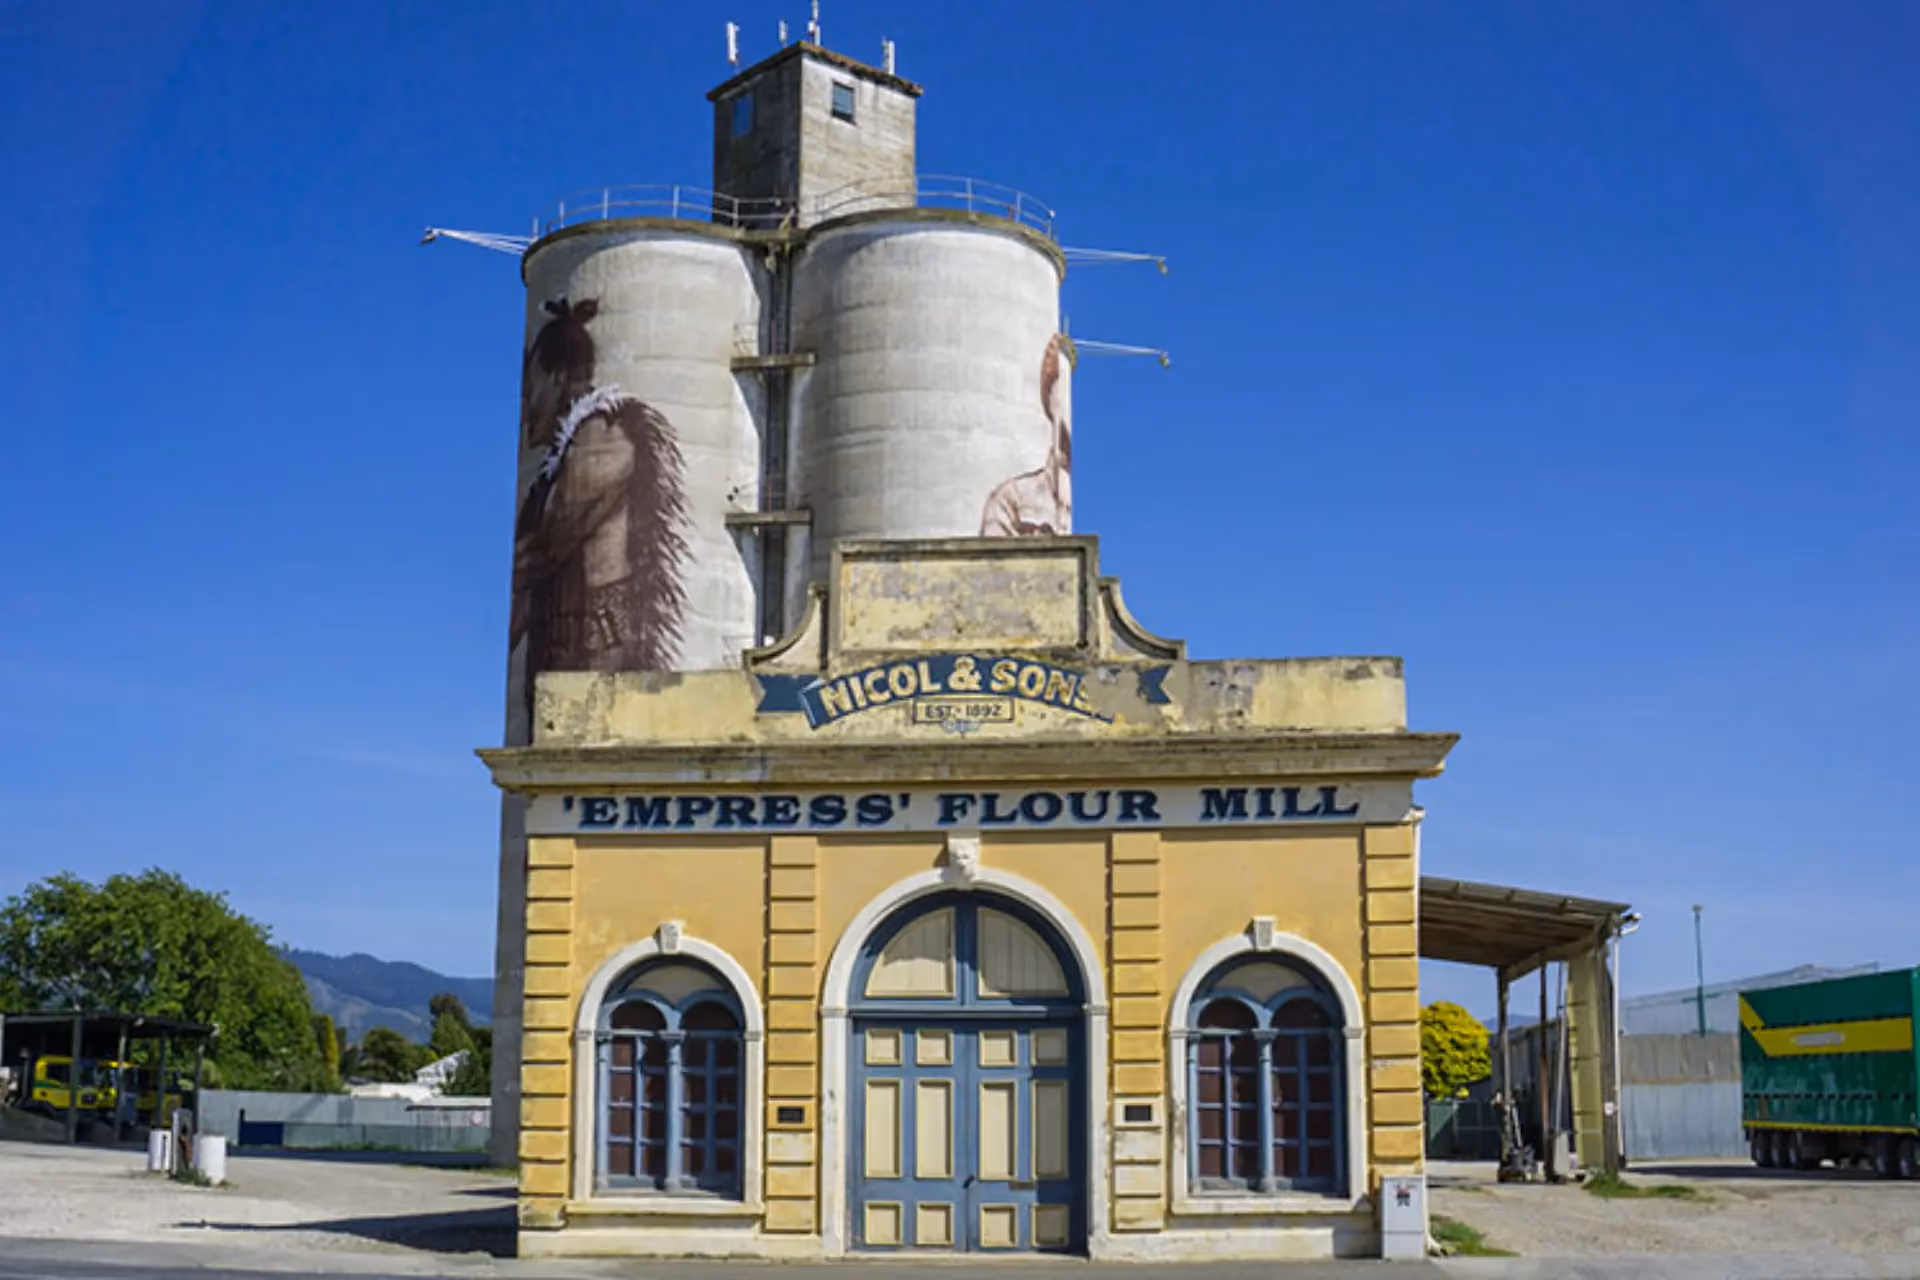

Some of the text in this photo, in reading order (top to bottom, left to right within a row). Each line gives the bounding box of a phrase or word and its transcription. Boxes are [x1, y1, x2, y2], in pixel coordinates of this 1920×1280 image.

[819, 660, 942, 718] NICOL
[948, 655, 983, 691] &
[966, 703, 1002, 717] 1892
[937, 789, 1161, 825] FLOUR
[1200, 786, 1360, 820] MILL
